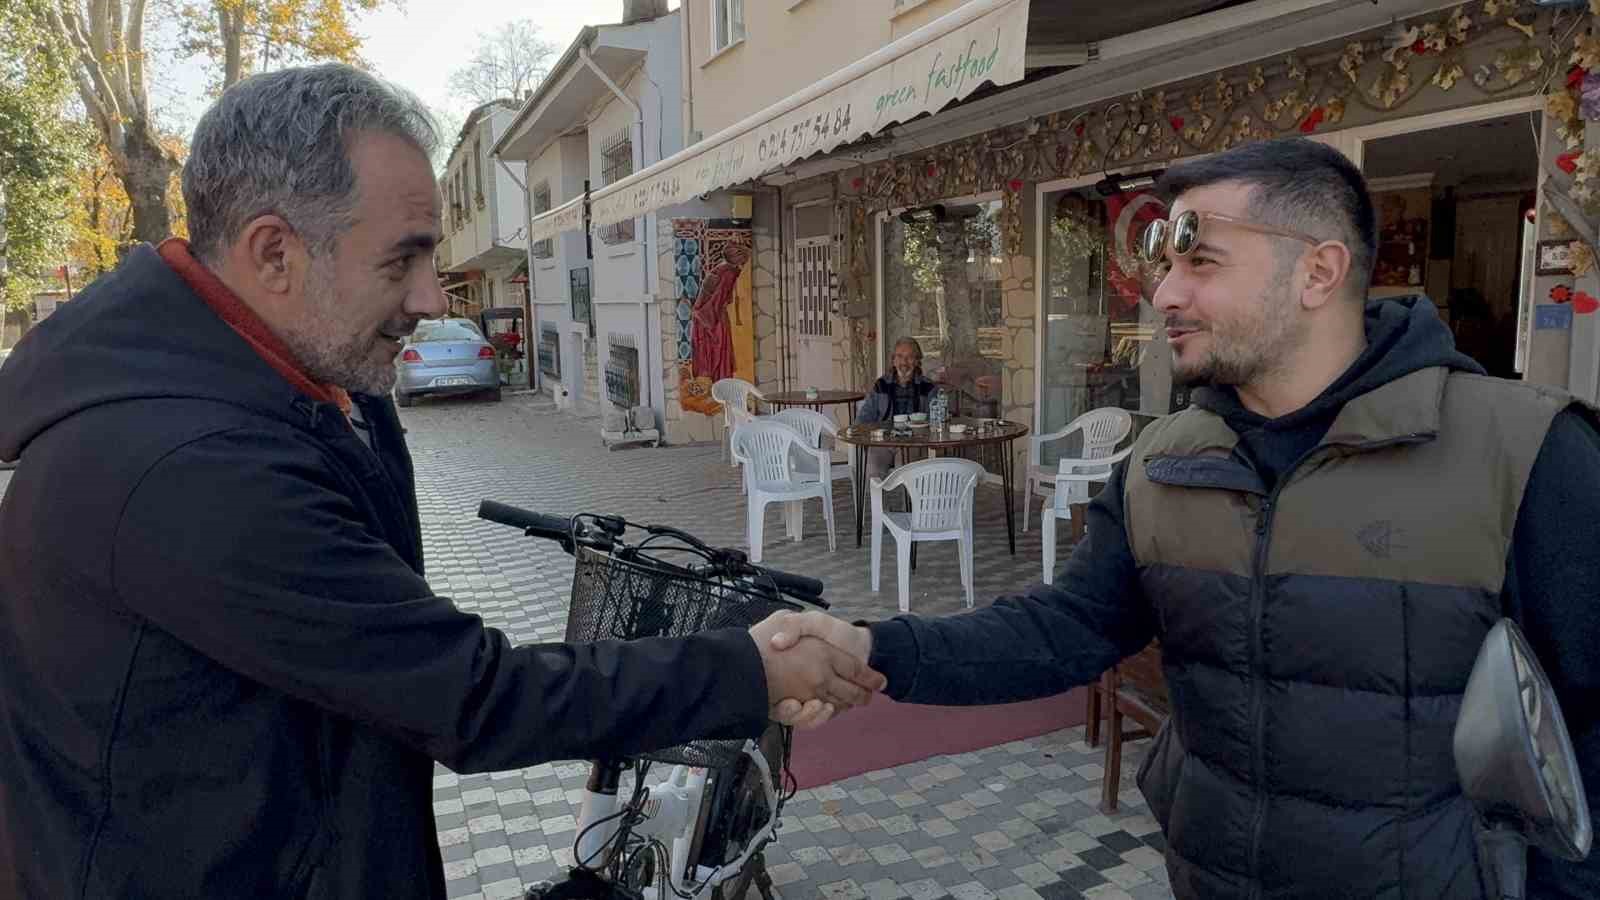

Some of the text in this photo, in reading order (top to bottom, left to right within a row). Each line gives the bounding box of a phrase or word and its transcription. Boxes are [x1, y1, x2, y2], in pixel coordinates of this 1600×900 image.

[873, 27, 1000, 128] green fastfood
[811, 111, 830, 146] 54
[833, 104, 851, 136] 84
